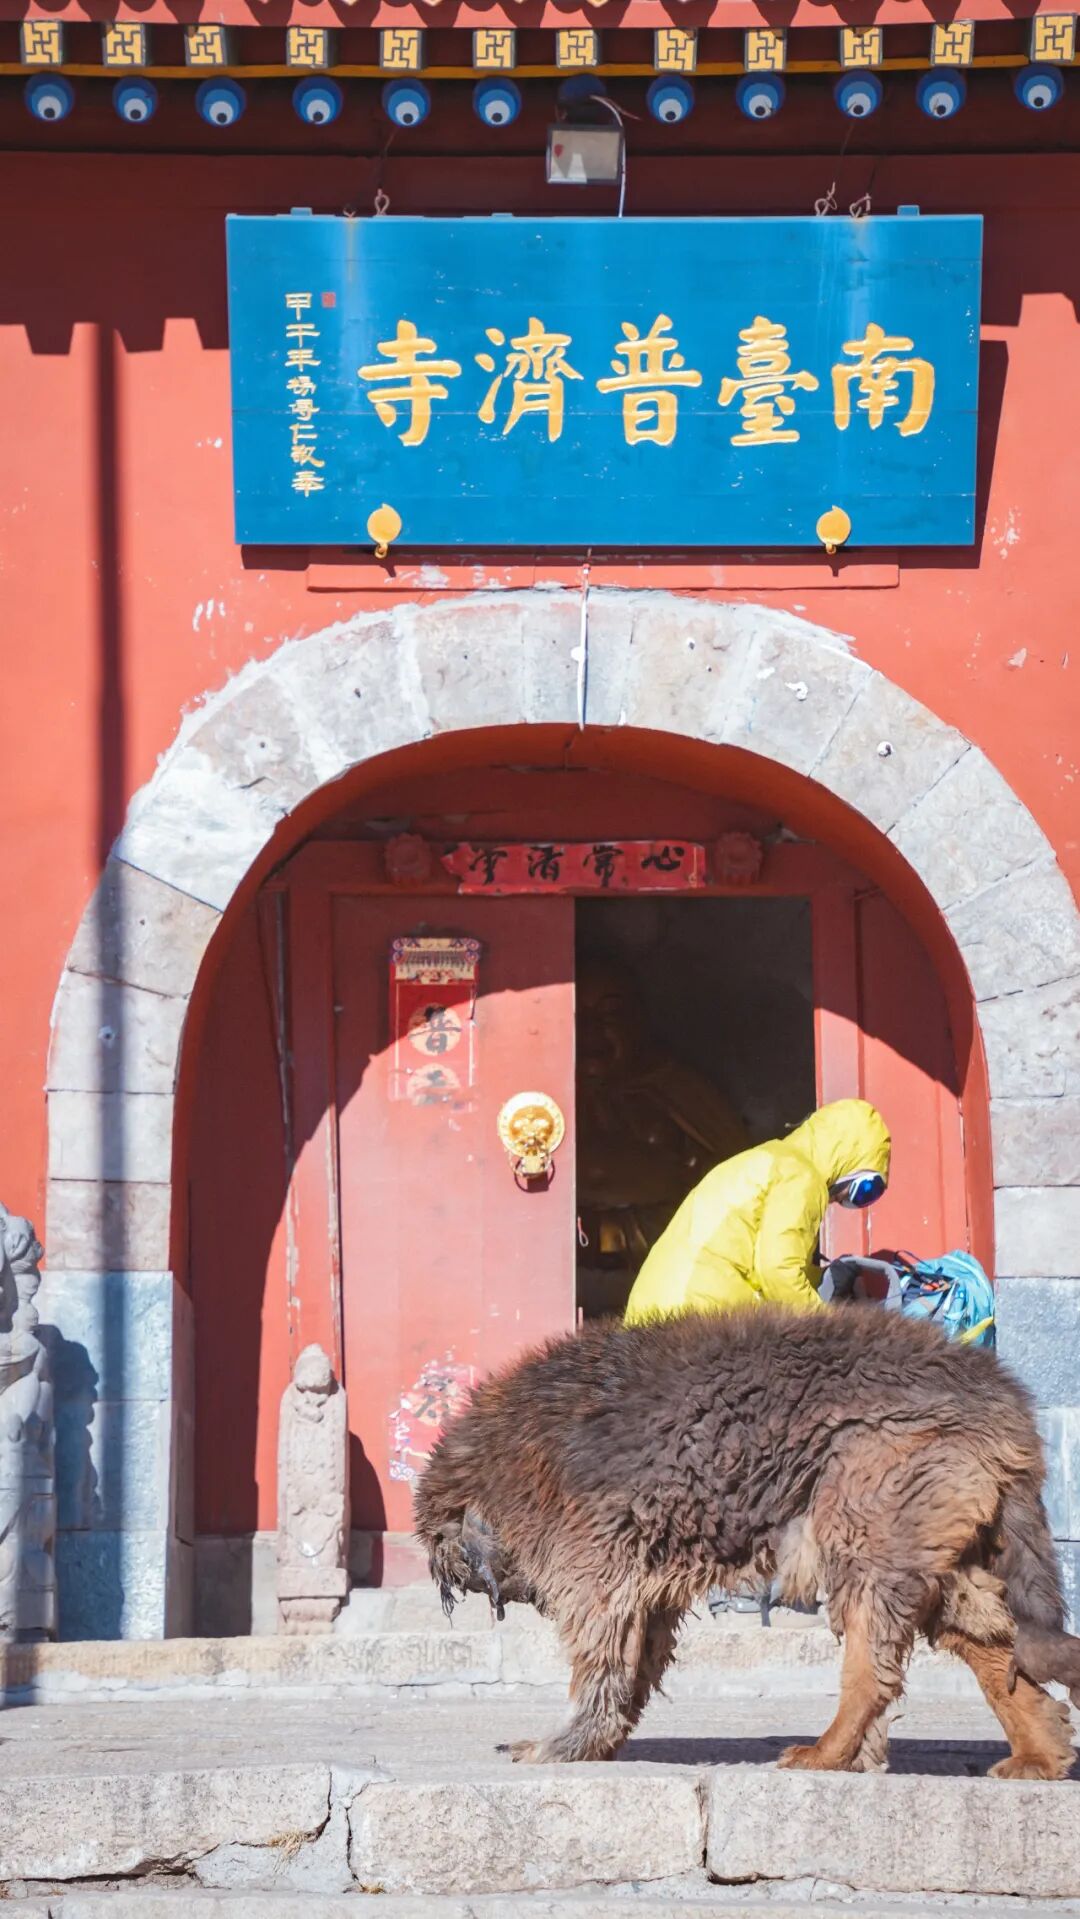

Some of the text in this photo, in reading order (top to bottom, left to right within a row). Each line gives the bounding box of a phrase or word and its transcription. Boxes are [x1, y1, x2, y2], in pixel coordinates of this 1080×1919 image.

[358, 314, 935, 446] 南臺普濟寺
